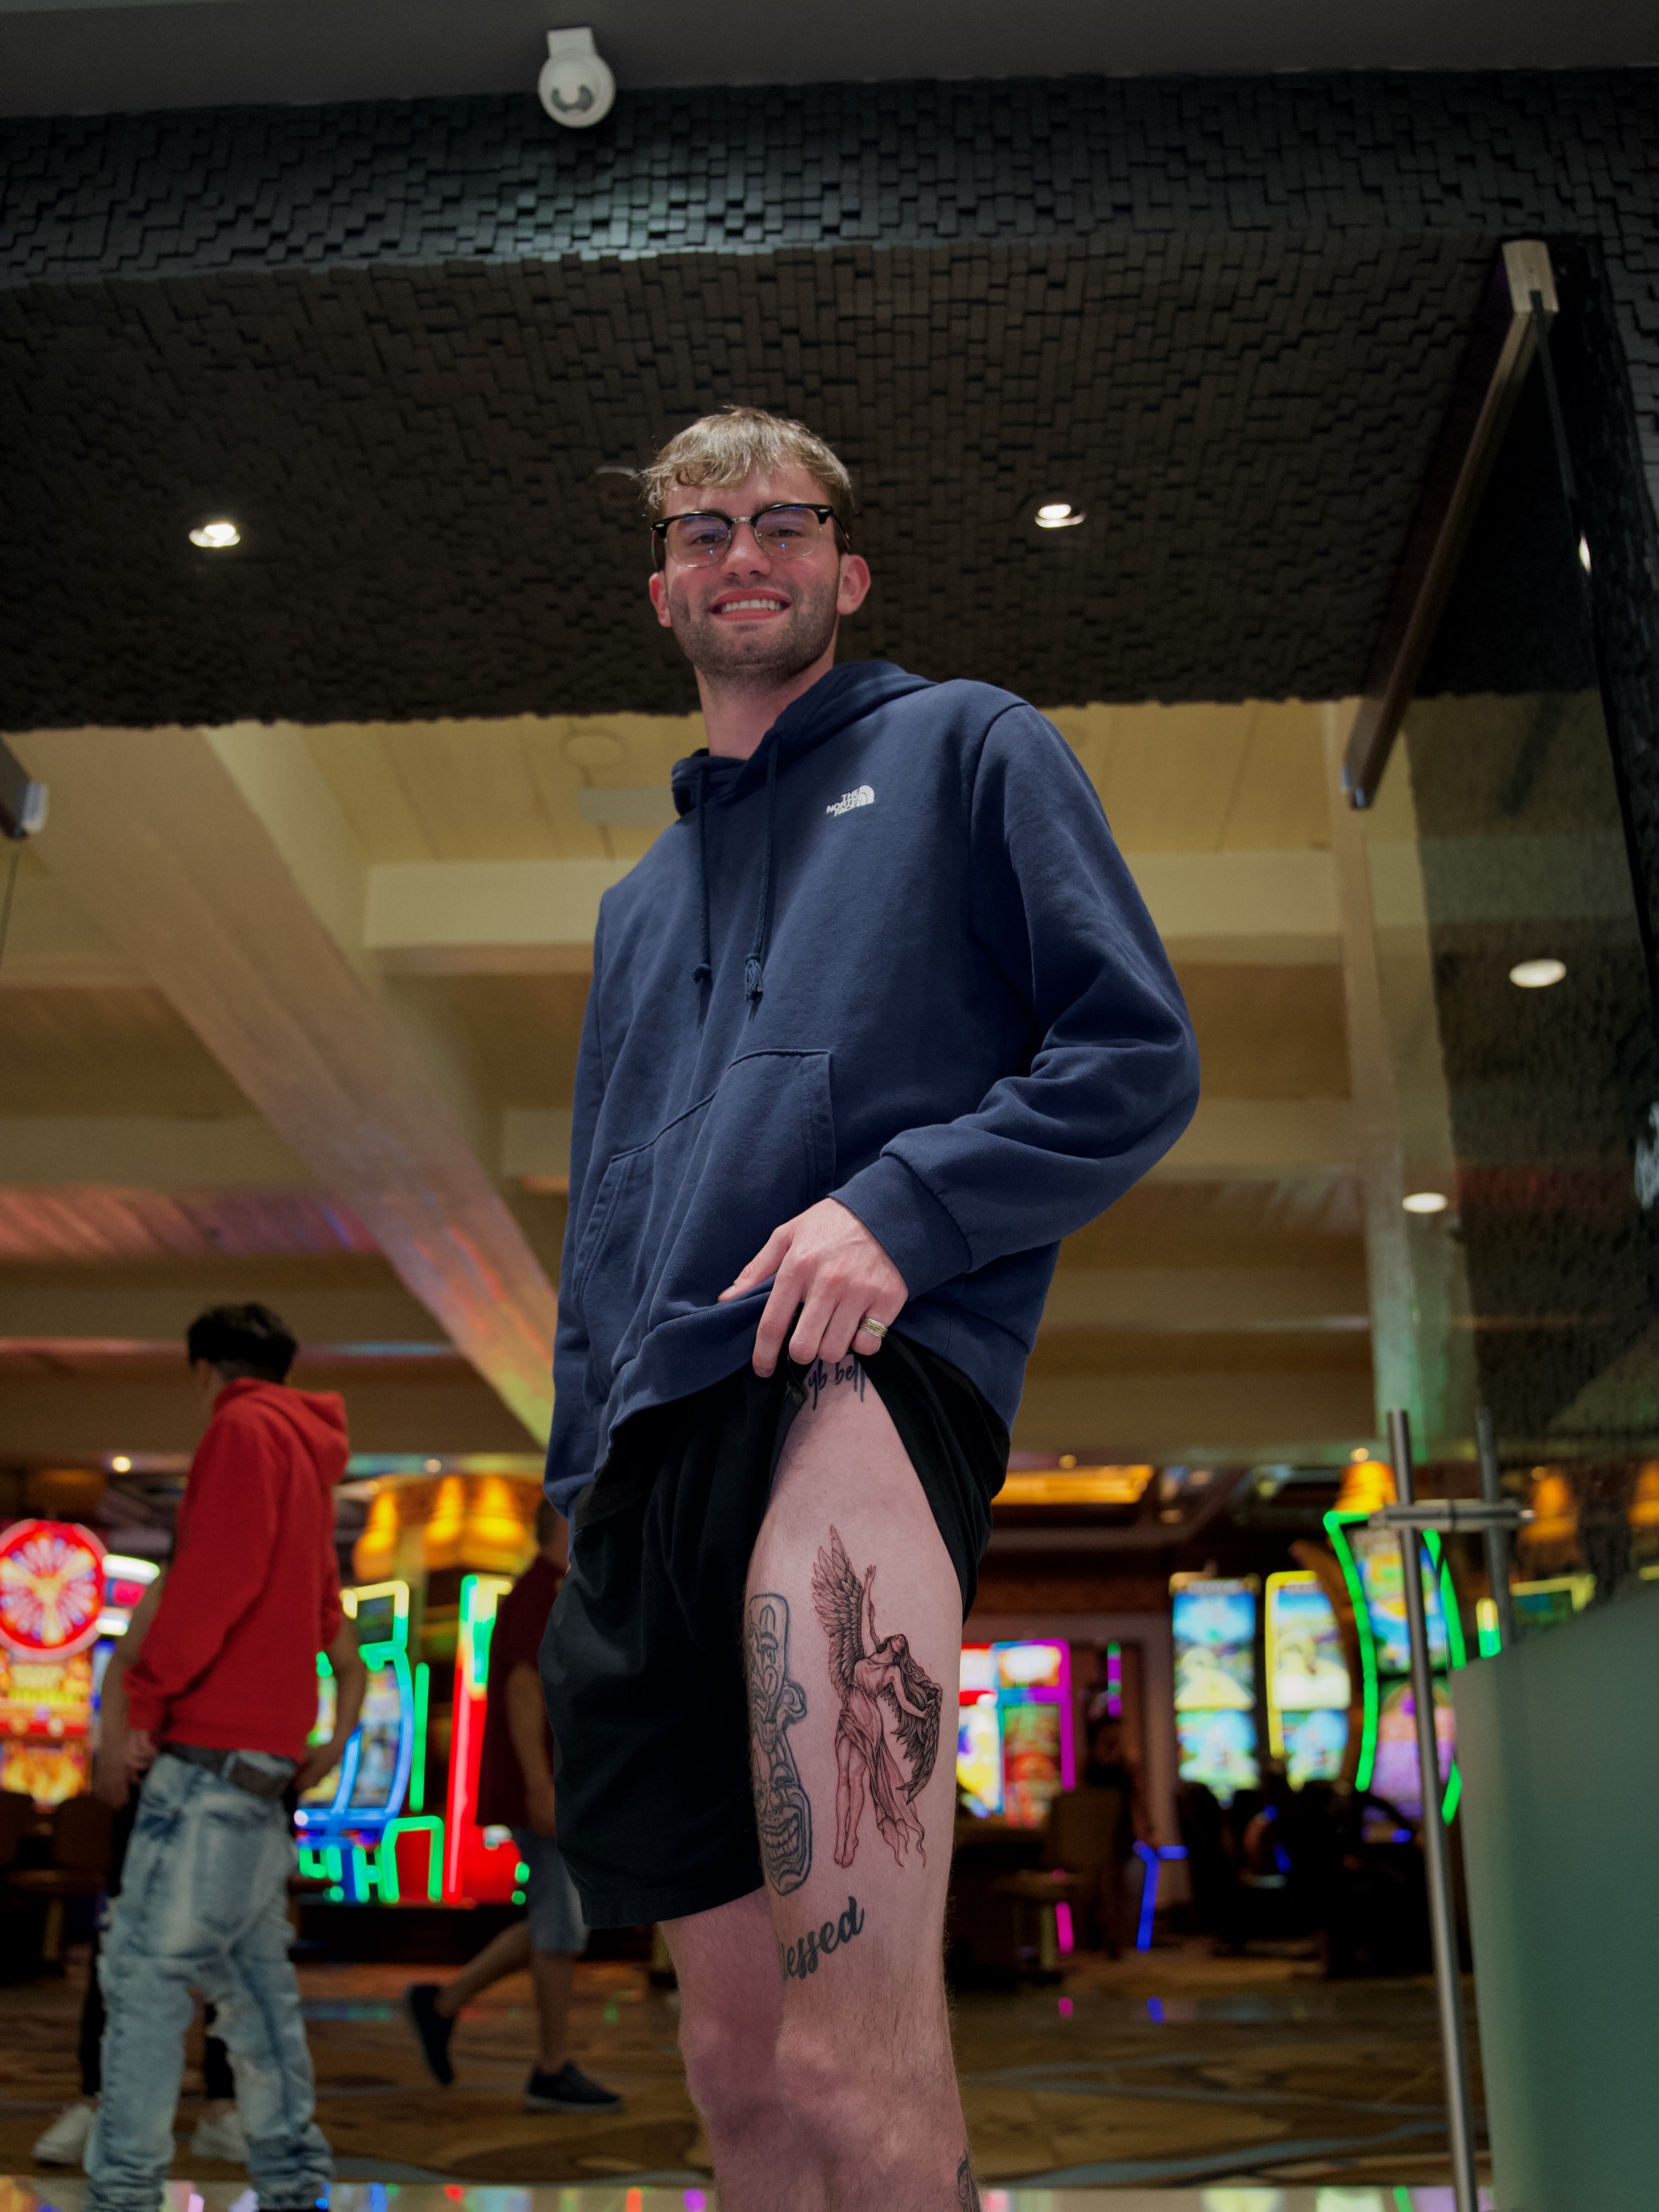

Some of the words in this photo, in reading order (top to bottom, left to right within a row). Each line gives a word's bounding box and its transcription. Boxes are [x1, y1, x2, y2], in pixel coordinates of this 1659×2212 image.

[841, 788, 859, 802] THE
[826, 796, 858, 814] NORTH
[834, 803, 857, 817] FACE
